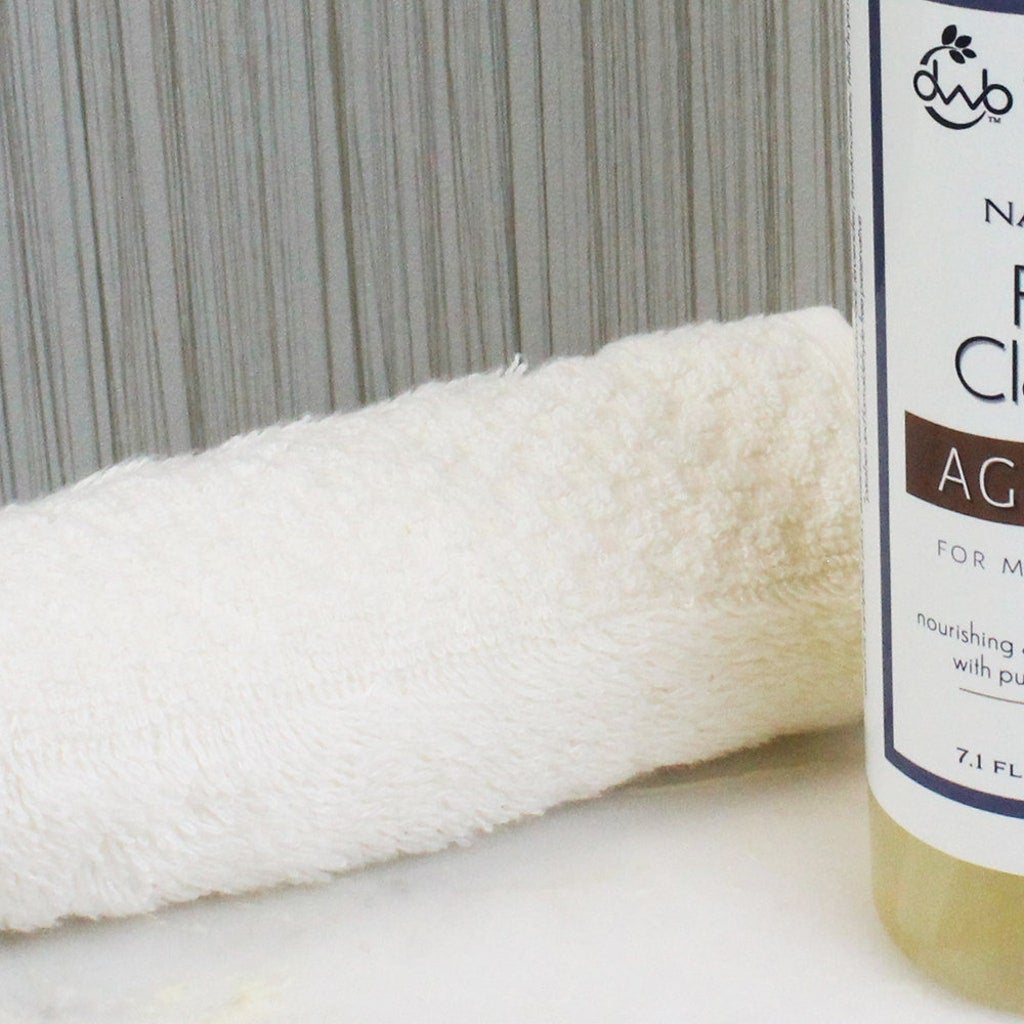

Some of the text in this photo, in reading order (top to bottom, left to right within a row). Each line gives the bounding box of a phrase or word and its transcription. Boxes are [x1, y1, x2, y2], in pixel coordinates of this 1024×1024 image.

[938, 540, 984, 569] FOR
[918, 611, 1014, 660] nourishing
[953, 655, 990, 678] with
[957, 747, 982, 769] 7.1
[994, 760, 1022, 778] FL
